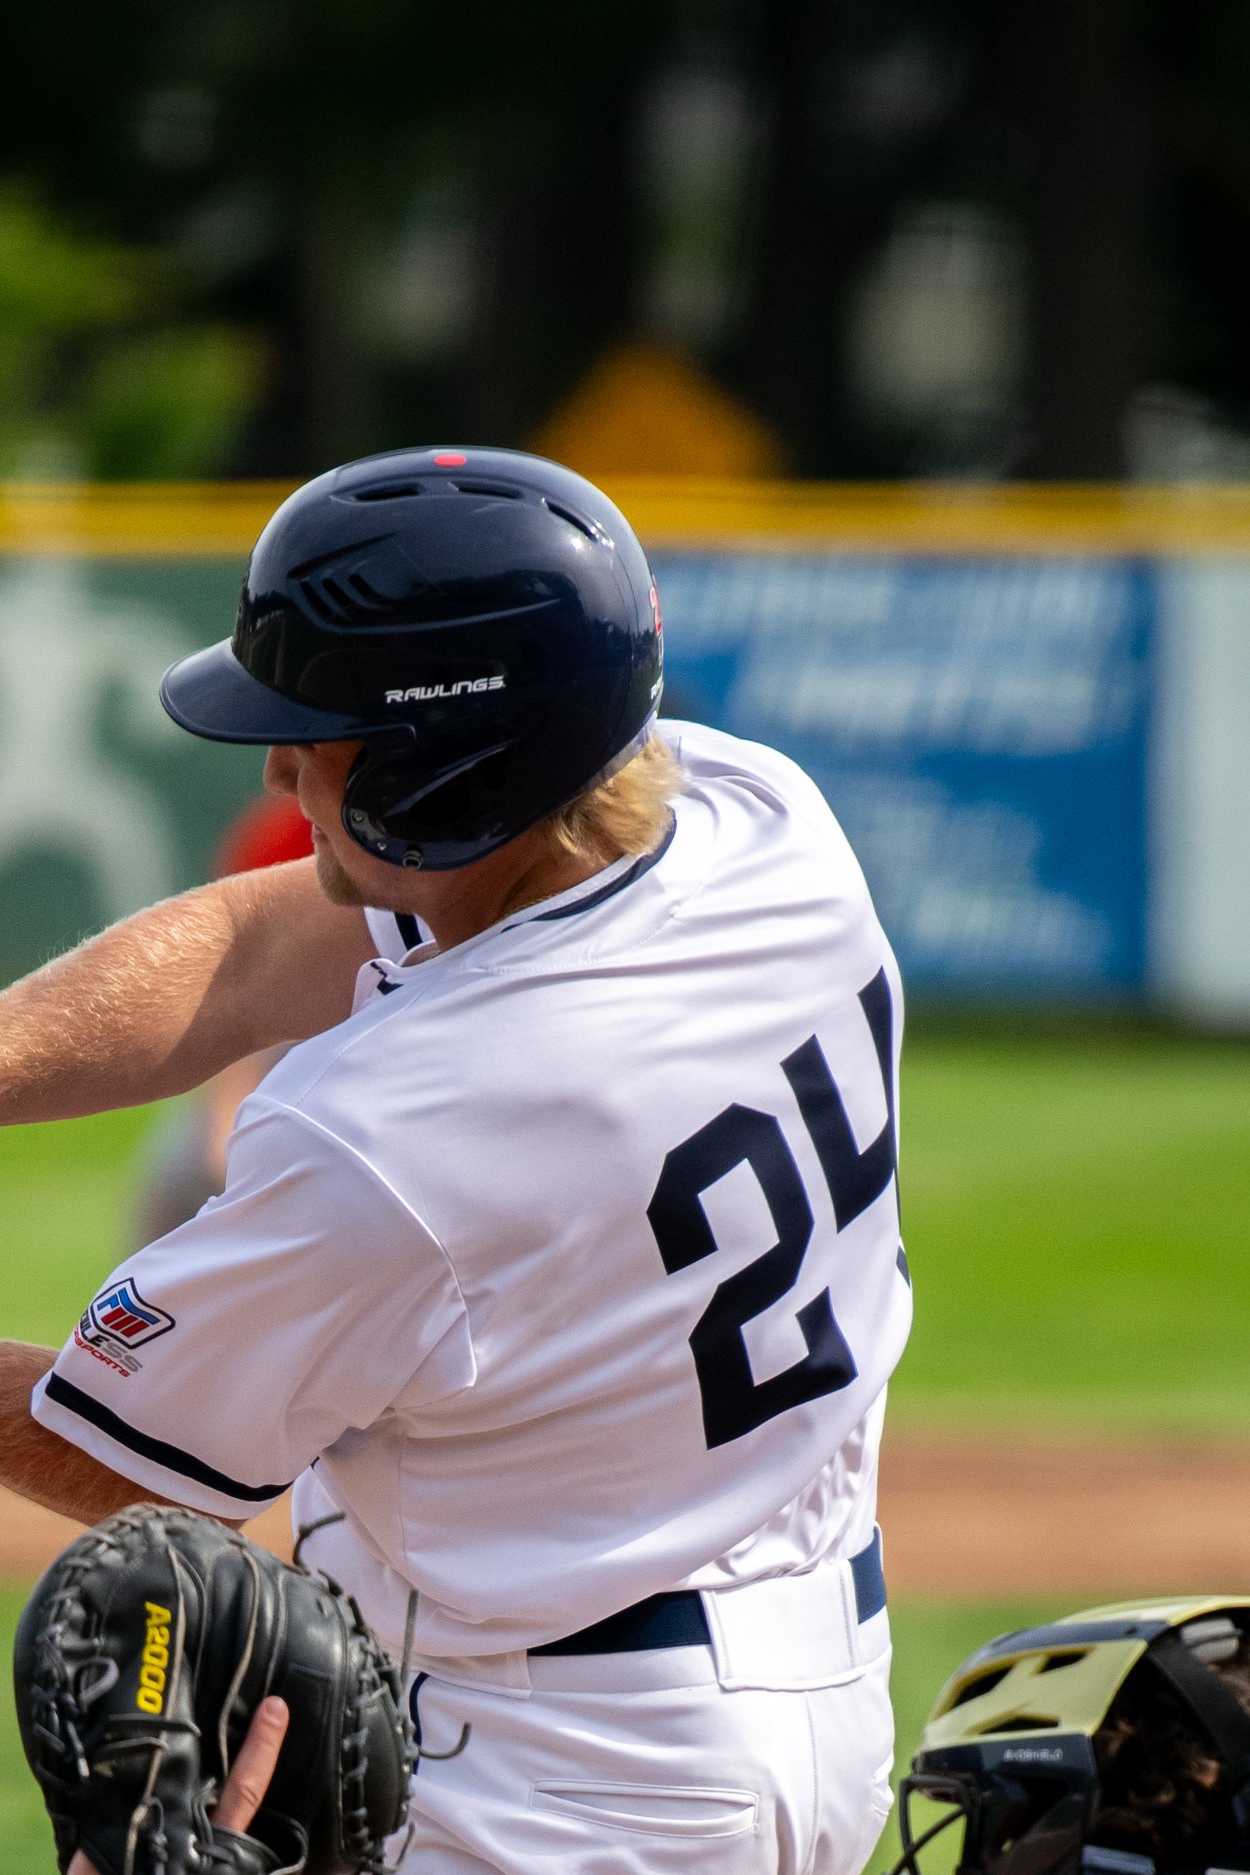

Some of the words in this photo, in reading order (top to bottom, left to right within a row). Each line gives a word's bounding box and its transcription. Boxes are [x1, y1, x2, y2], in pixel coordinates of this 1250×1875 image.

[385, 676, 505, 704] RAWLINGS
[646, 965, 902, 1451] 24
[136, 1600, 172, 1715] A2000
